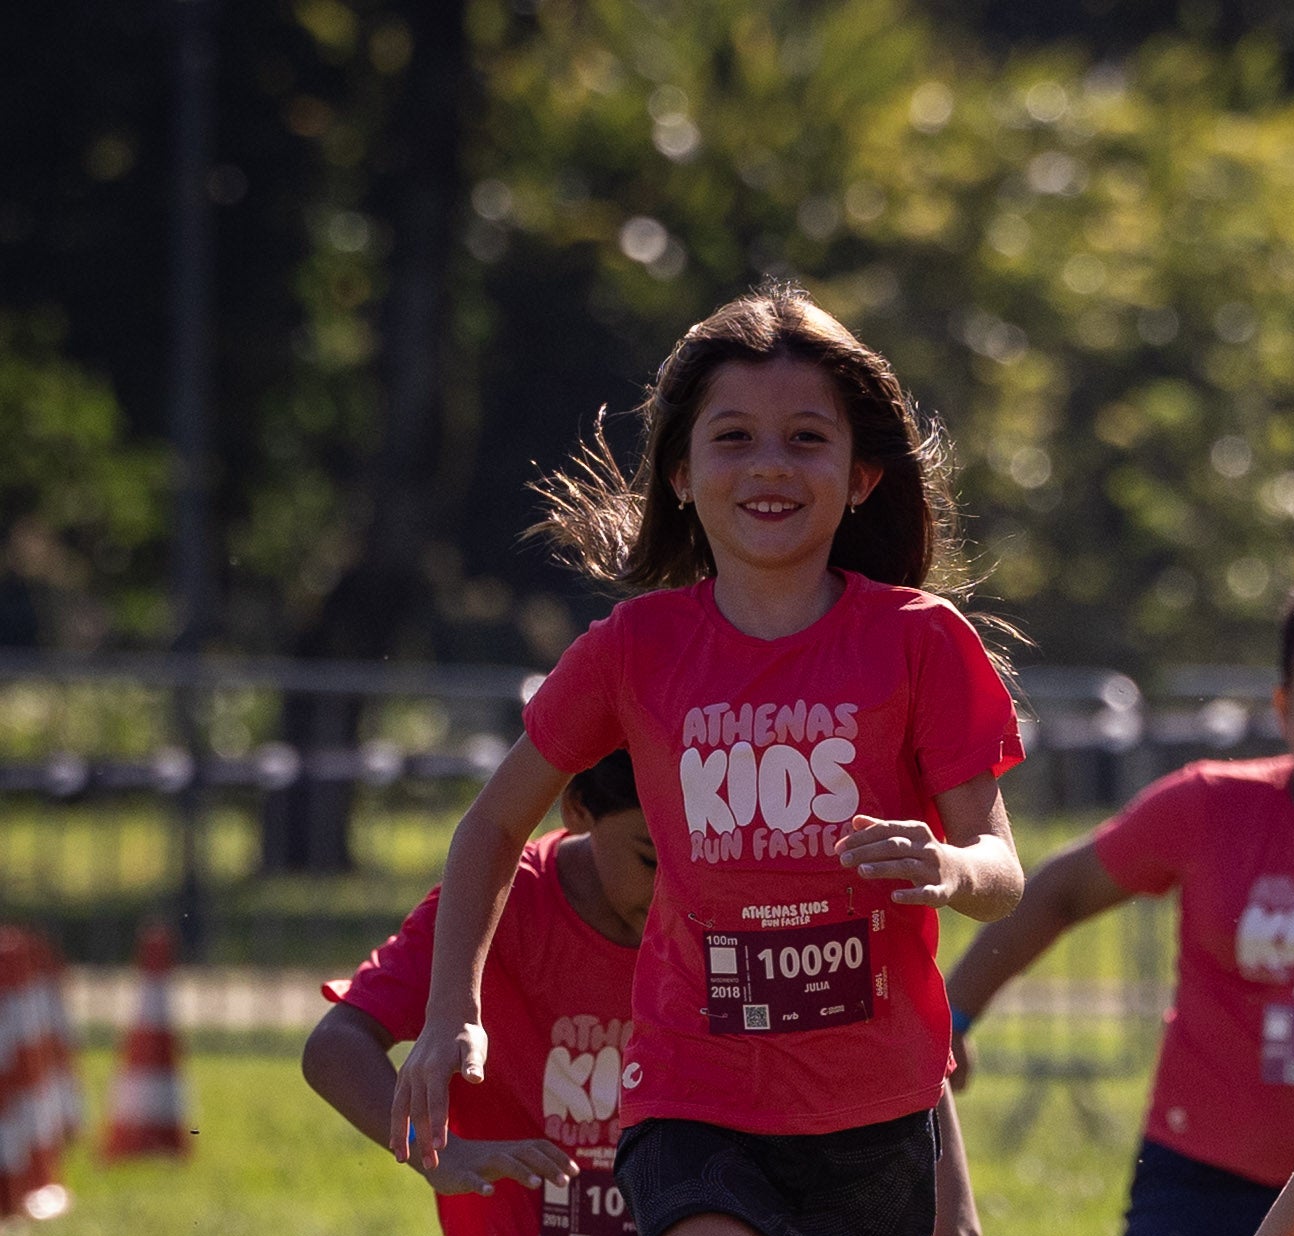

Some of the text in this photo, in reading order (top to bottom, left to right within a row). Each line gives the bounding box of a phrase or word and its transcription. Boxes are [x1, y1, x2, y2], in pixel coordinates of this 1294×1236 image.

[683, 699, 858, 747] ATHENAS
[680, 737, 859, 838] KIDS
[691, 828, 743, 864] RUN
[742, 901, 829, 919] ATHENAS KIDS
[761, 915, 810, 928] RUN FASTER
[706, 936, 738, 946] 100m
[757, 937, 863, 980] 10090
[711, 986, 741, 998] 2018
[804, 981, 831, 993] JULIA
[782, 1012, 799, 1022] rvb
[543, 1046, 620, 1123] KI
[544, 1115, 600, 1146] RUN
